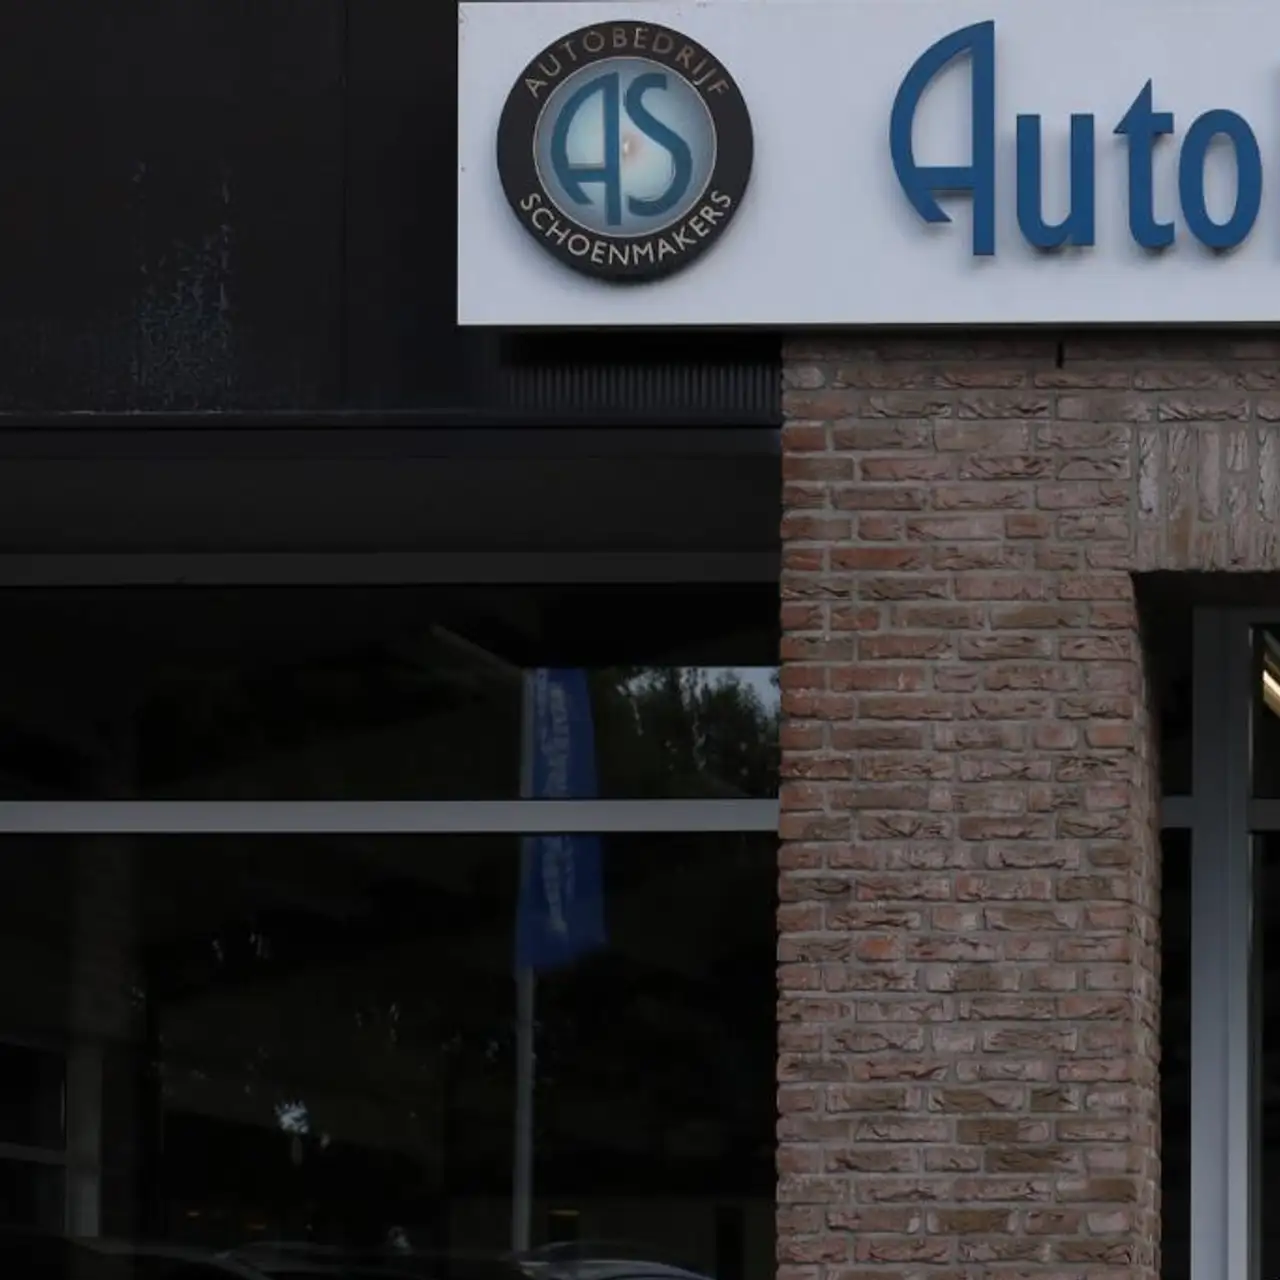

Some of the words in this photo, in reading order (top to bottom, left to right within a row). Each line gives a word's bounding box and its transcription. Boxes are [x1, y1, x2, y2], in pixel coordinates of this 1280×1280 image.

[524, 26, 731, 99] AUTOBEDRIJF
[550, 71, 694, 227] AS
[519, 190, 733, 267] SCHOENMAKERS
